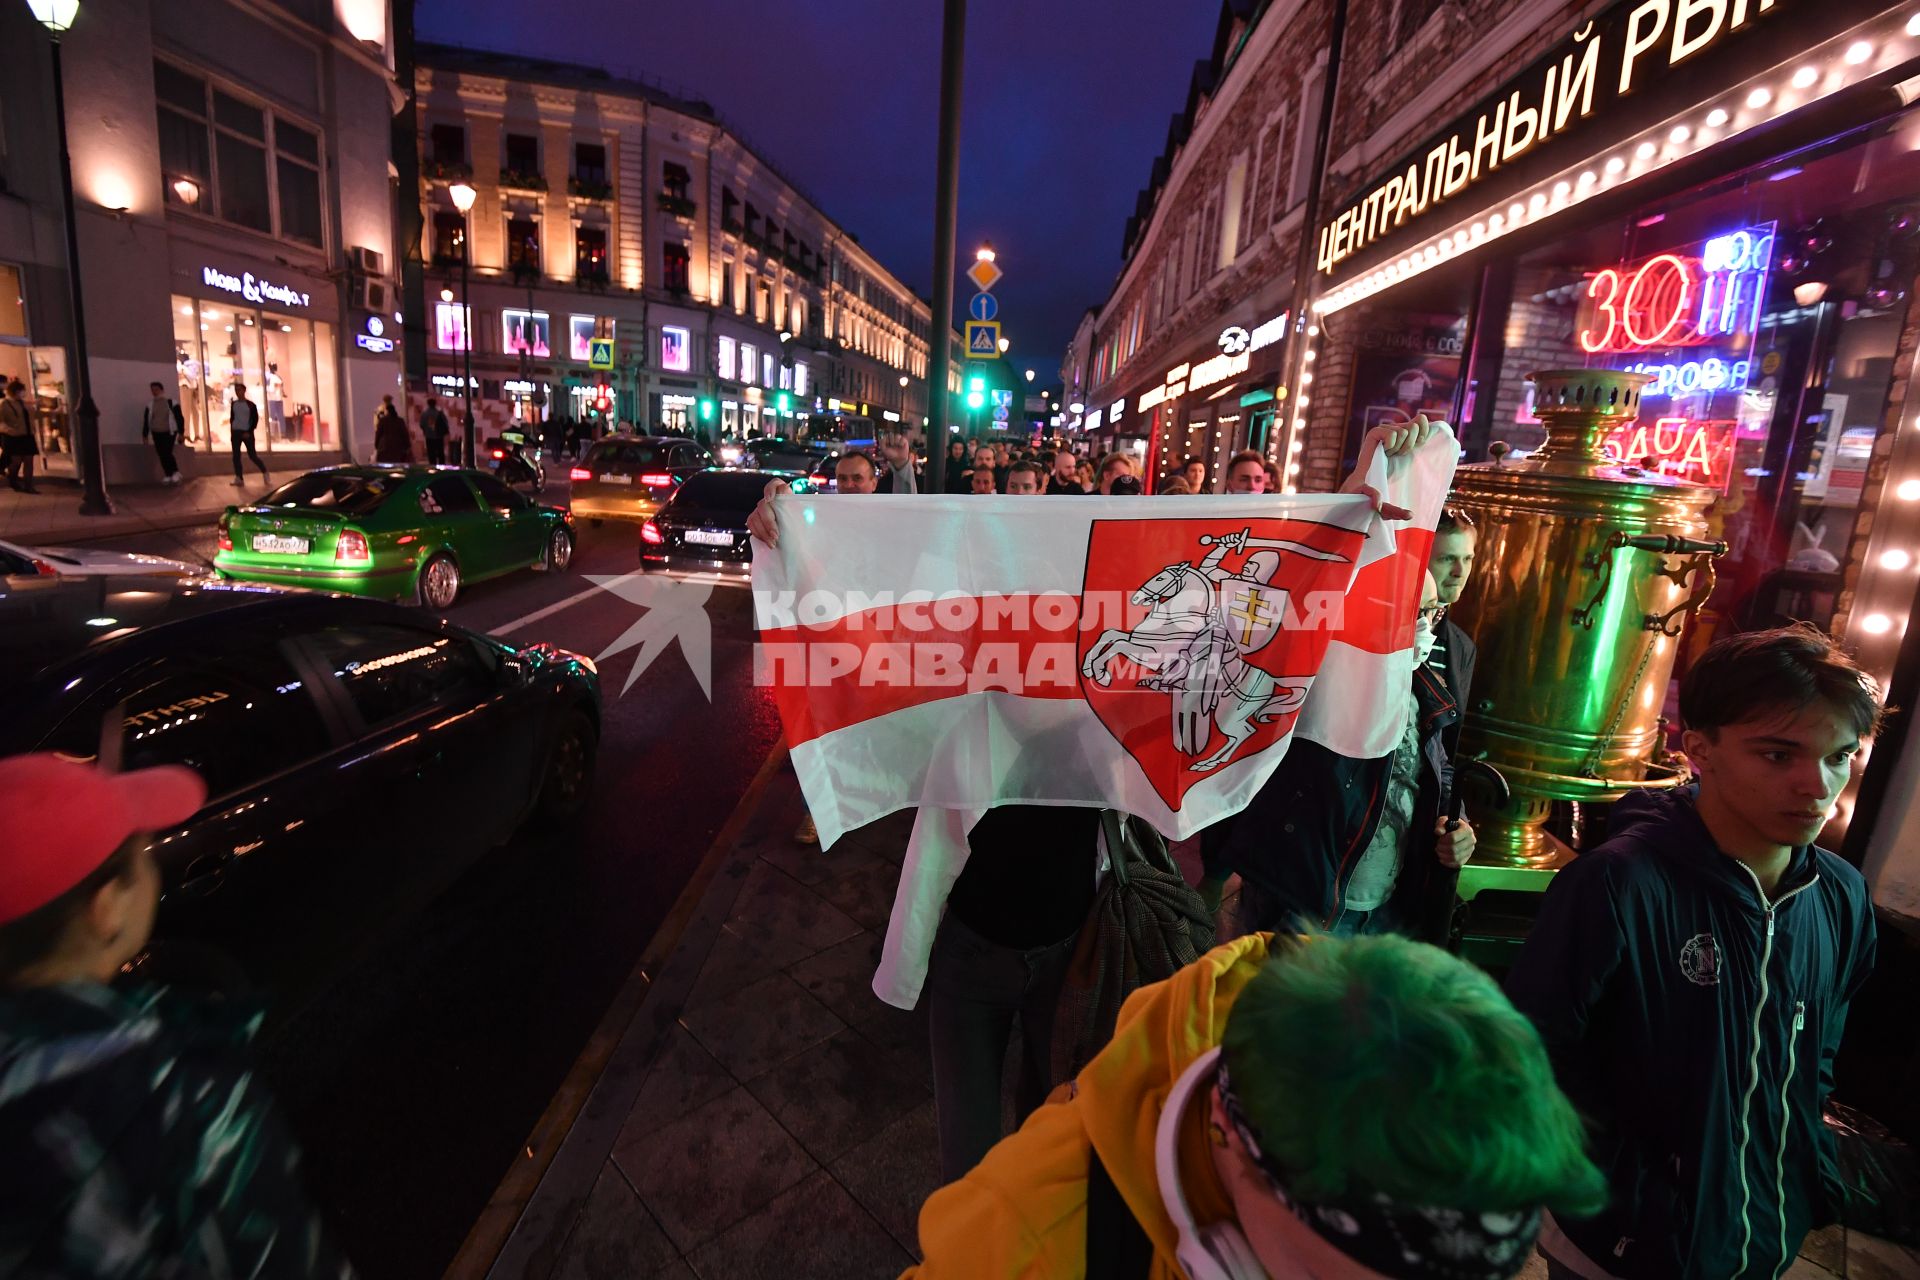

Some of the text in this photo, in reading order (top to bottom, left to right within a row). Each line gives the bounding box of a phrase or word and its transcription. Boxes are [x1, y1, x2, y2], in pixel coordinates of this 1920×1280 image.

[1317, 0, 1775, 274] ЦЕНТРАЛЬНЫЙ РЫ
[204, 267, 242, 292] Мода
[243, 272, 264, 303] &
[1580, 254, 1689, 352] 30
